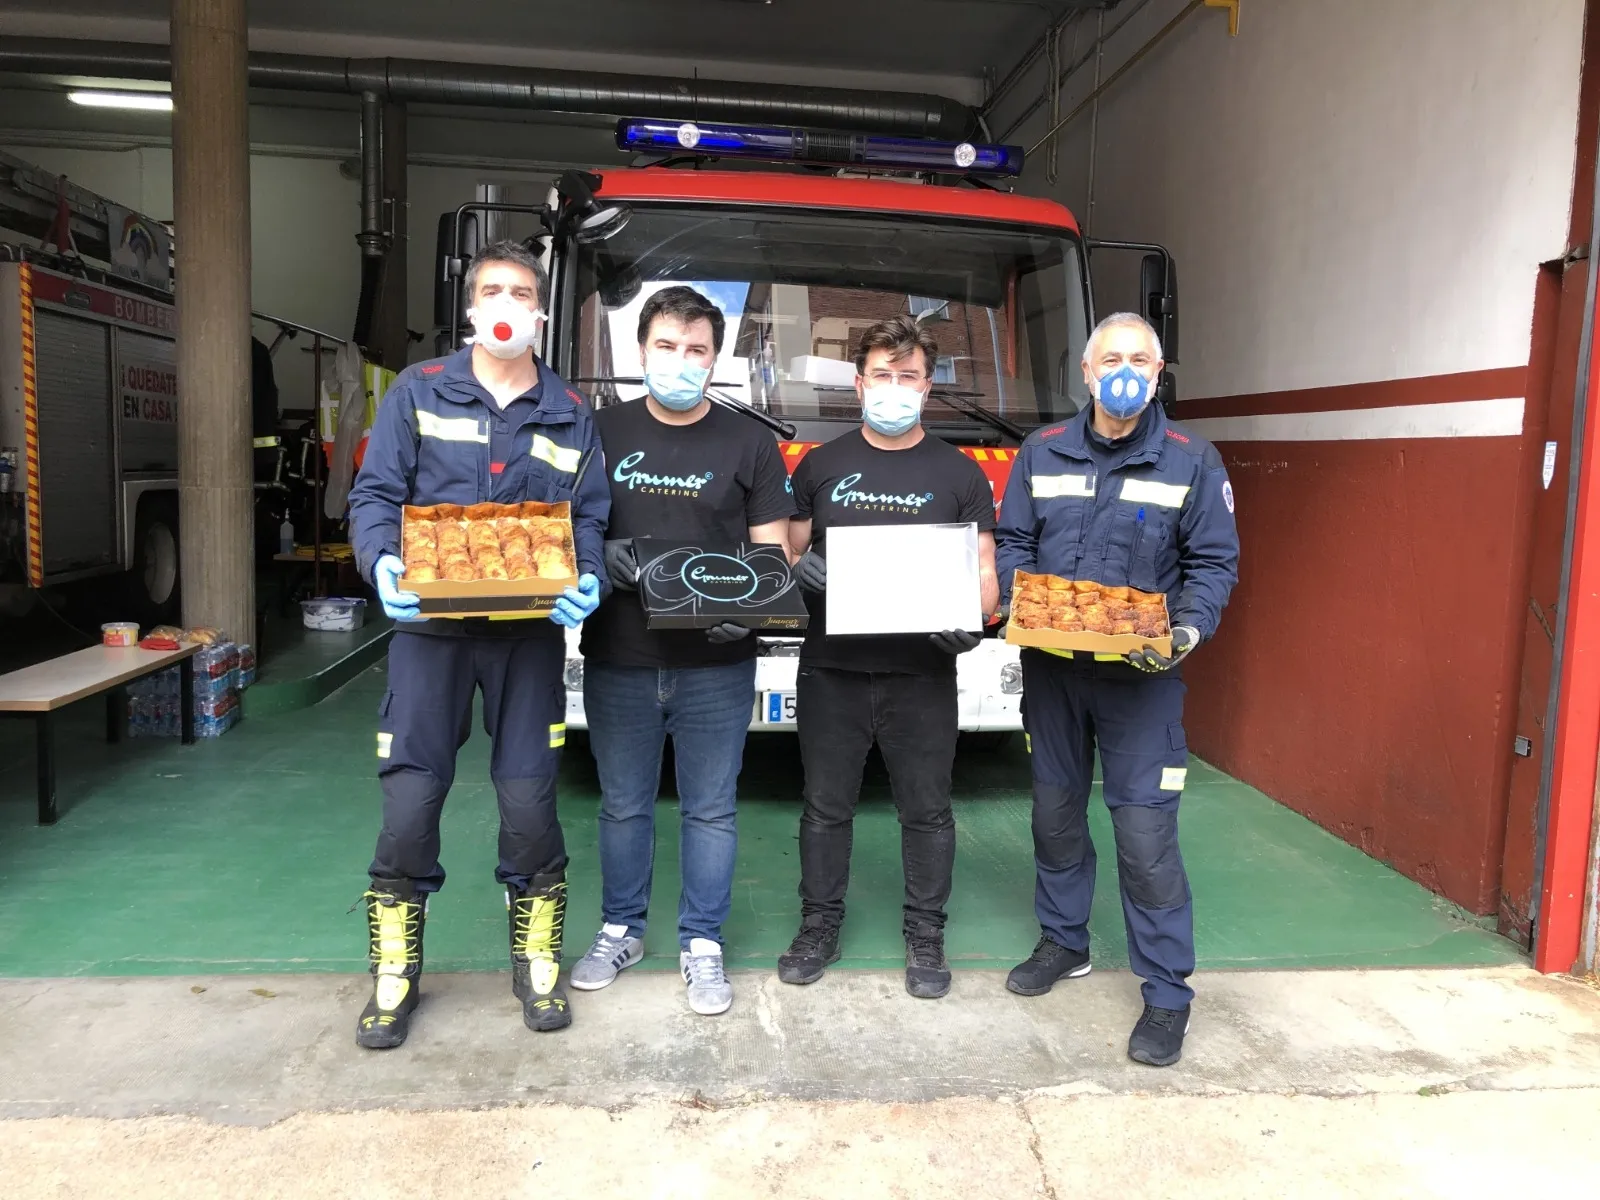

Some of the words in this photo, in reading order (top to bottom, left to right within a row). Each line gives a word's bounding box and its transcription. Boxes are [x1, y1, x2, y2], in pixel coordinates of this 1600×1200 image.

[123, 395, 139, 419] EN
[143, 398, 173, 422] CASA
[640, 486, 699, 498] CATERING
[855, 503, 919, 515] CATERING
